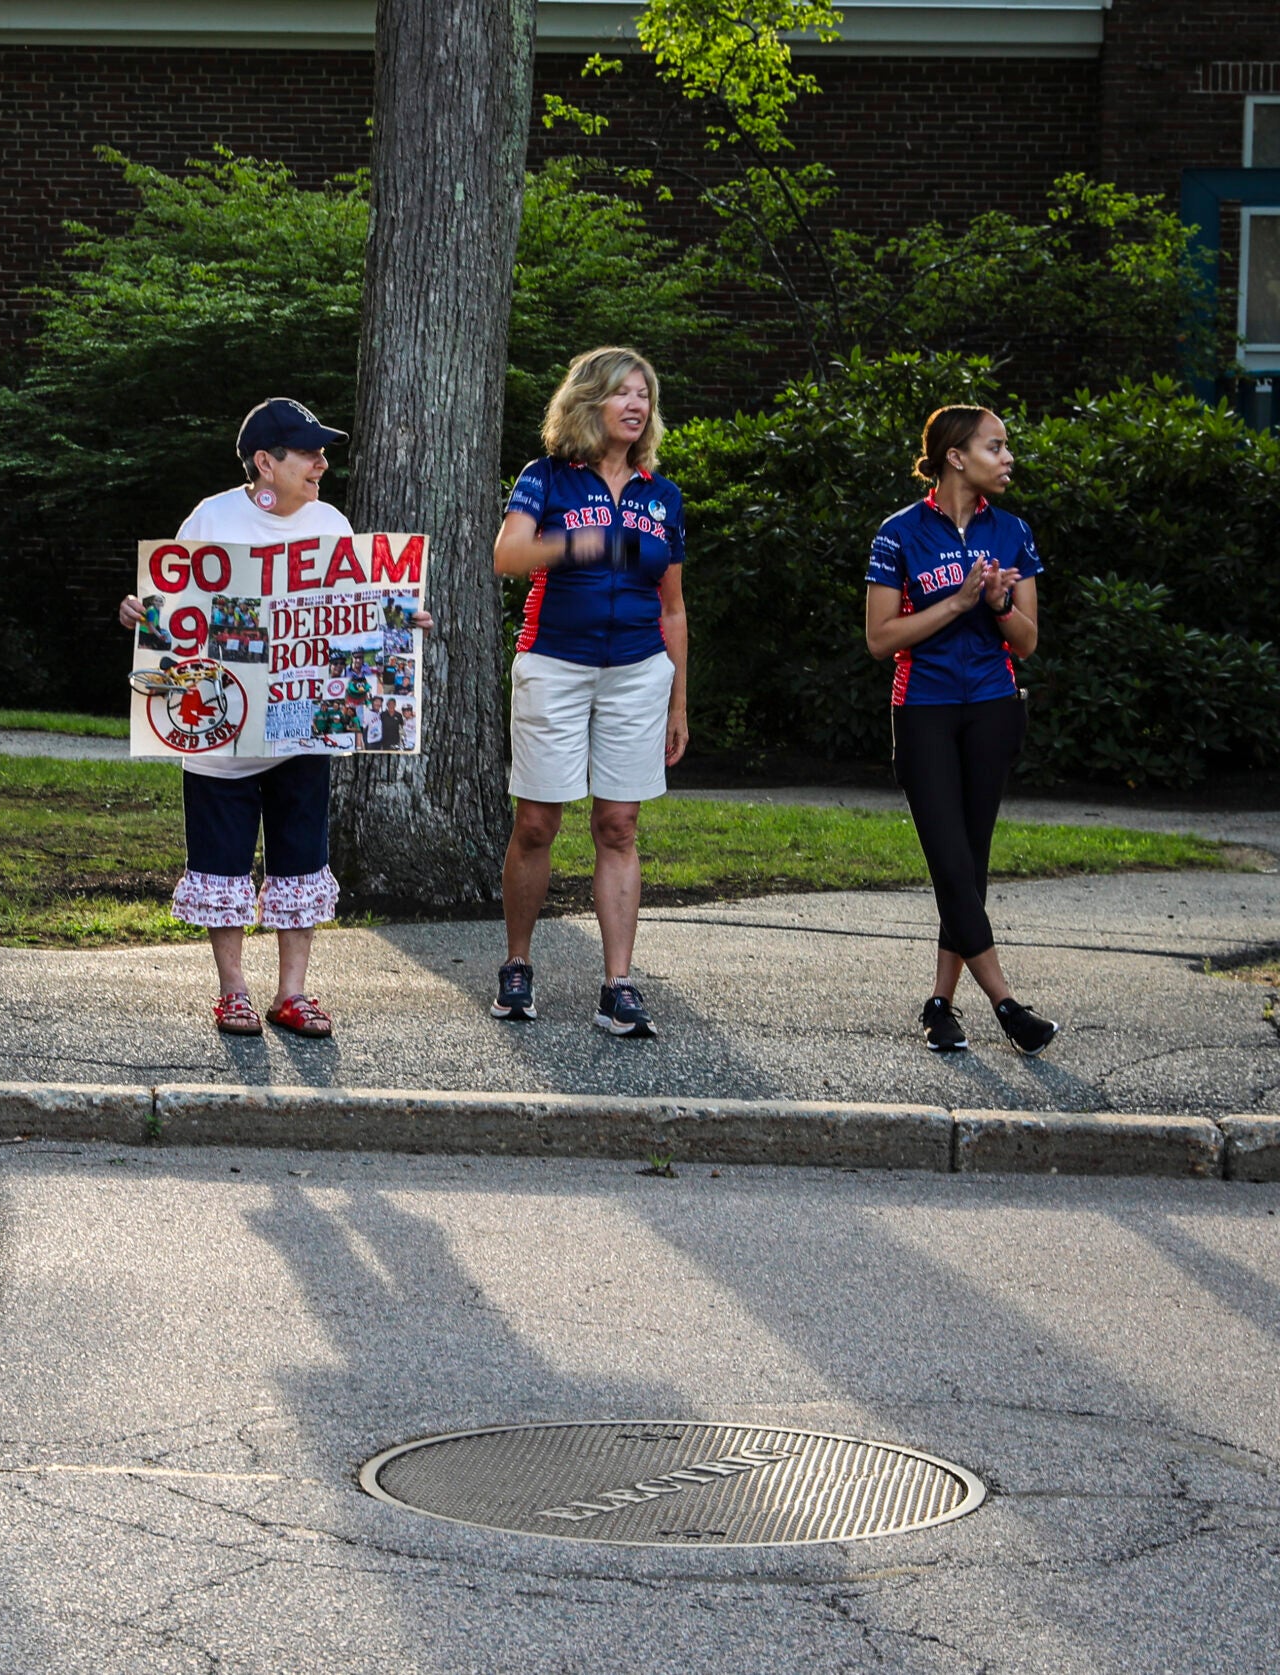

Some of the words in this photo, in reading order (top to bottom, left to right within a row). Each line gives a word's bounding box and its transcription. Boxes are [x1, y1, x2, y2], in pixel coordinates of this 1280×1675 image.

[587, 494, 611, 502] PMC
[563, 506, 612, 530] RED
[622, 511, 666, 540] SOX
[148, 544, 232, 593] GO
[250, 534, 424, 596] TEAM
[940, 551, 962, 560] PMC
[917, 562, 964, 595] RED
[169, 606, 209, 657] 9
[271, 602, 379, 641] DEBBIE
[269, 638, 330, 674] BOB
[268, 679, 324, 703] SUE
[165, 727, 200, 749] RED
[205, 718, 239, 746] SOX
[535, 1447, 794, 1521] ELECTRIC
